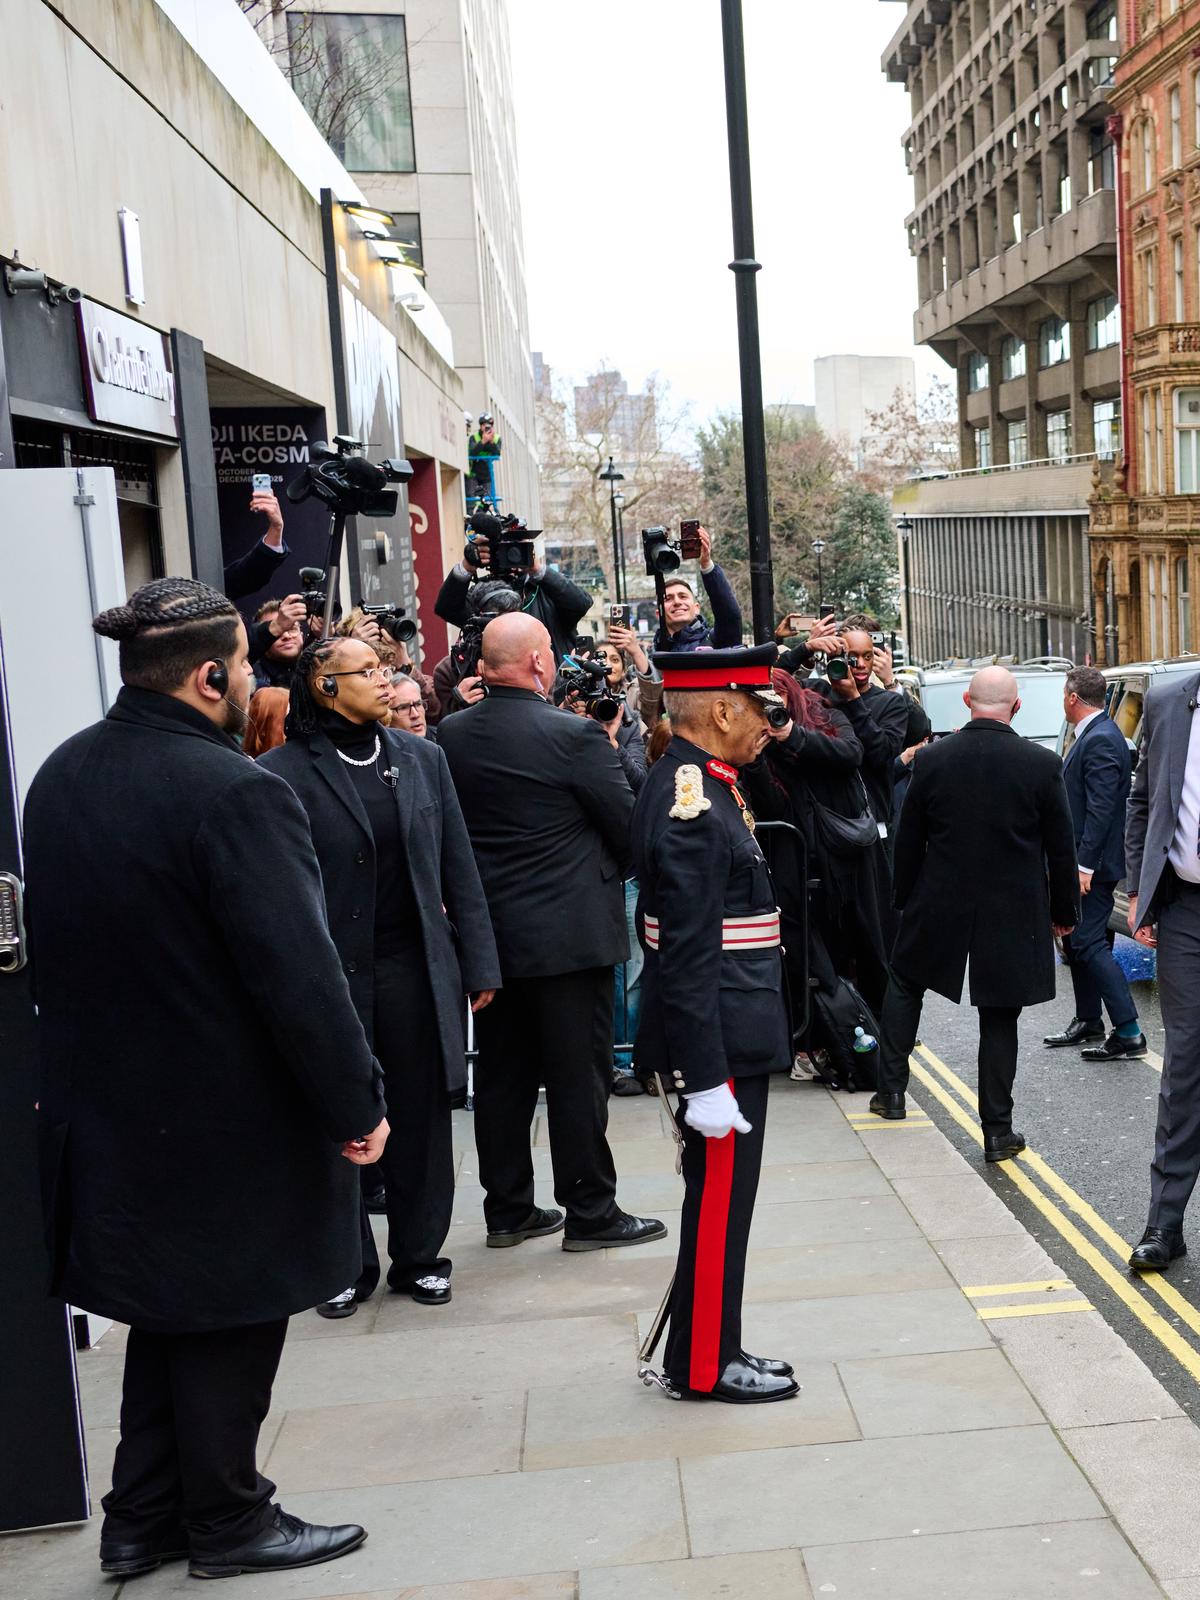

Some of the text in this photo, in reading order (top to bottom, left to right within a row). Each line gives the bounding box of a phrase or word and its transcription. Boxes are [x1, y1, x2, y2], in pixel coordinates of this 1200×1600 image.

[211, 424, 308, 442] OJI IKEDA
[213, 446, 310, 464] TA-COSM
[218, 468, 256, 476] OCTOBER
